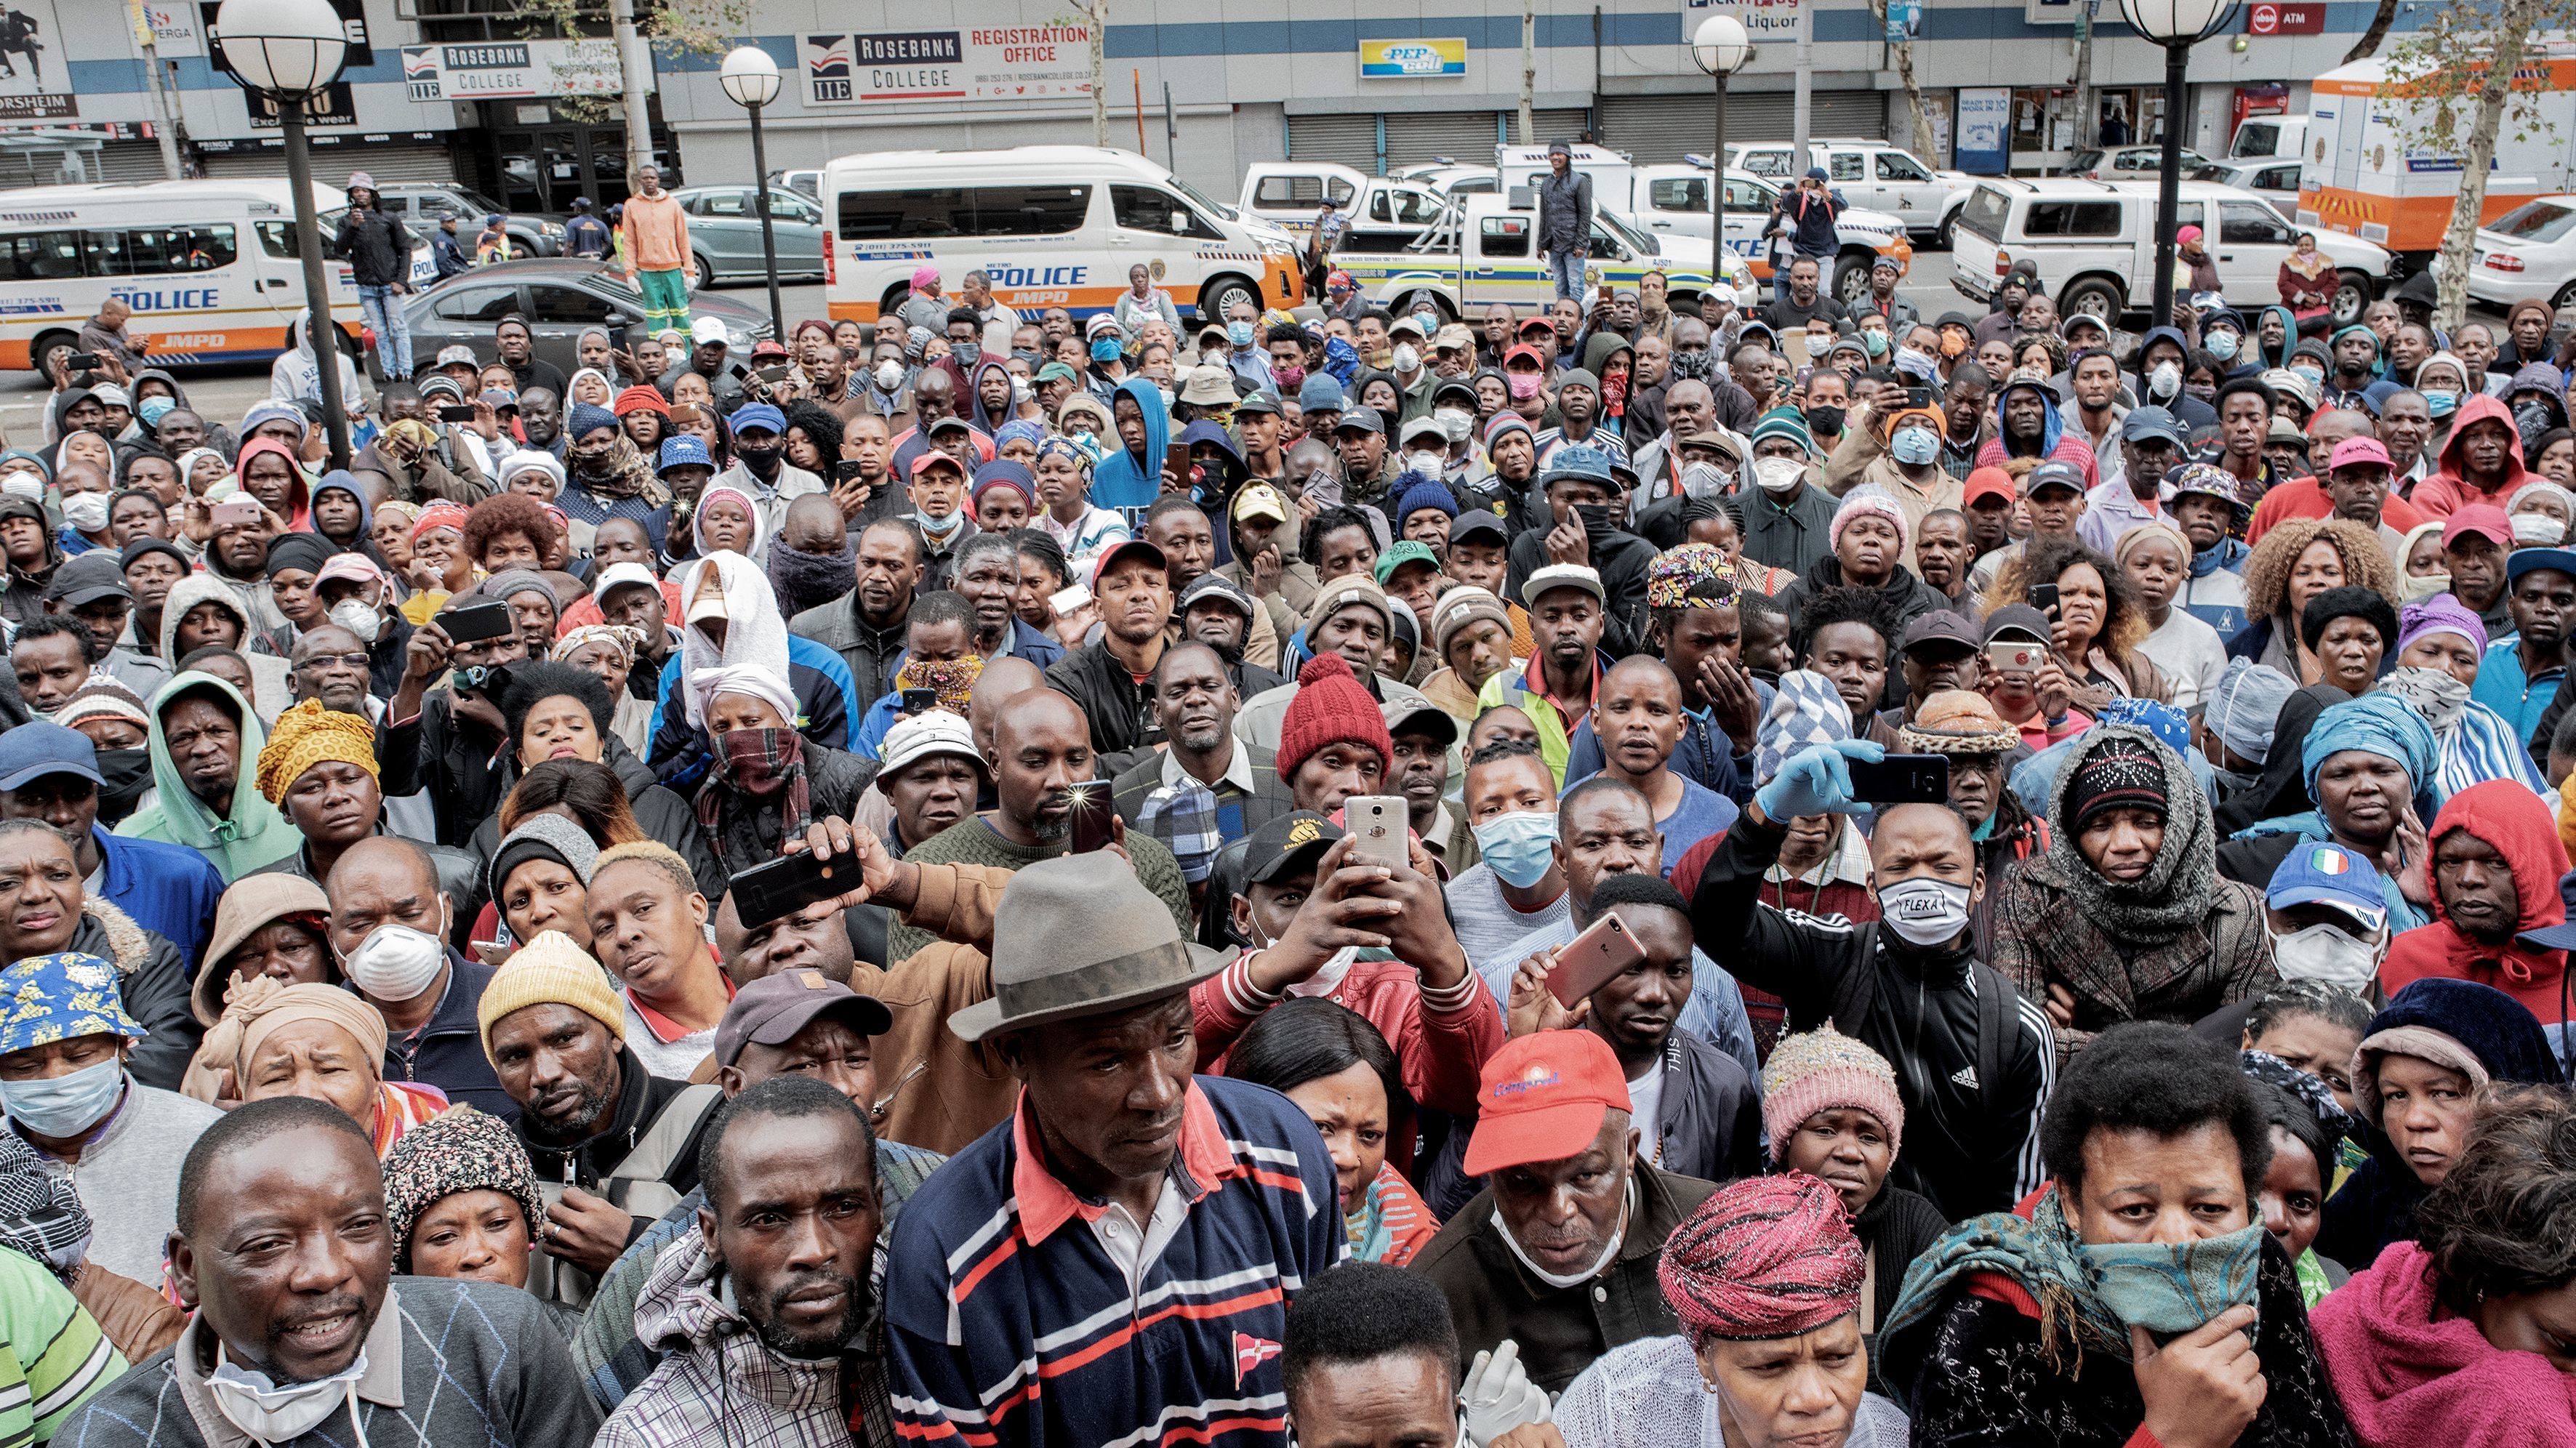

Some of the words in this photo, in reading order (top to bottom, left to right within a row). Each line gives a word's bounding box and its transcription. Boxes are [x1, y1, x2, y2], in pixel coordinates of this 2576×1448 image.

[1747, 15, 1798, 31] Liquor
[2283, 13, 2305, 23] ATM
[972, 27, 1088, 46] REGISTRATION
[448, 47, 526, 66] ROSEBANK
[862, 38, 955, 60] ROSEBANK
[1005, 47, 1057, 63] OFFICE
[1389, 48, 1428, 60] PEP
[460, 73, 523, 89] COLLEGE
[872, 69, 950, 89] COLLEGE
[410, 84, 441, 99] IIE
[815, 81, 852, 100] IIE
[318, 115, 353, 125] wear
[987, 267, 1087, 286] POLICE
[111, 289, 218, 311] POLICE
[1007, 290, 1070, 305] JMPD
[159, 334, 227, 348] JMPD
[1667, 1037, 1682, 1072] THIS
[1951, 1074, 1979, 1090] adidas
